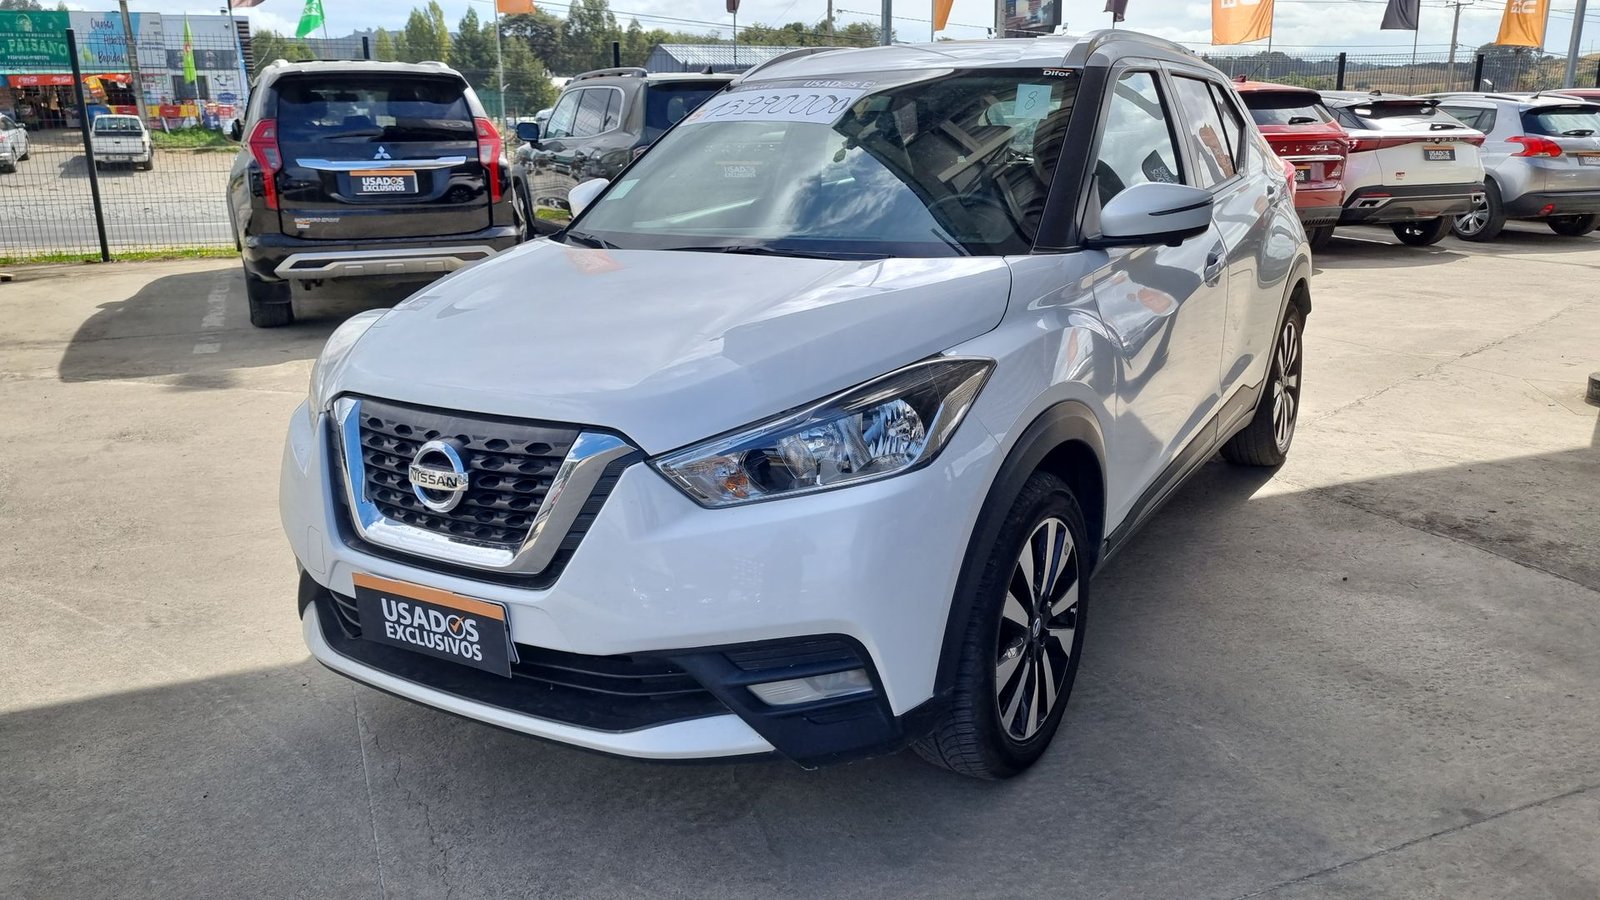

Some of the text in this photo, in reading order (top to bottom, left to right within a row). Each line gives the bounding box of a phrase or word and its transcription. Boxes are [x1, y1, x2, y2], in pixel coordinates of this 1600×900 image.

[7, 38, 68, 56] PAISANO
[1025, 91, 1038, 110] 8
[361, 176, 405, 186] USADOS
[410, 466, 458, 488] NISSAN
[381, 598, 480, 643] USADOS
[384, 621, 483, 662] EXCLUSIVOS
